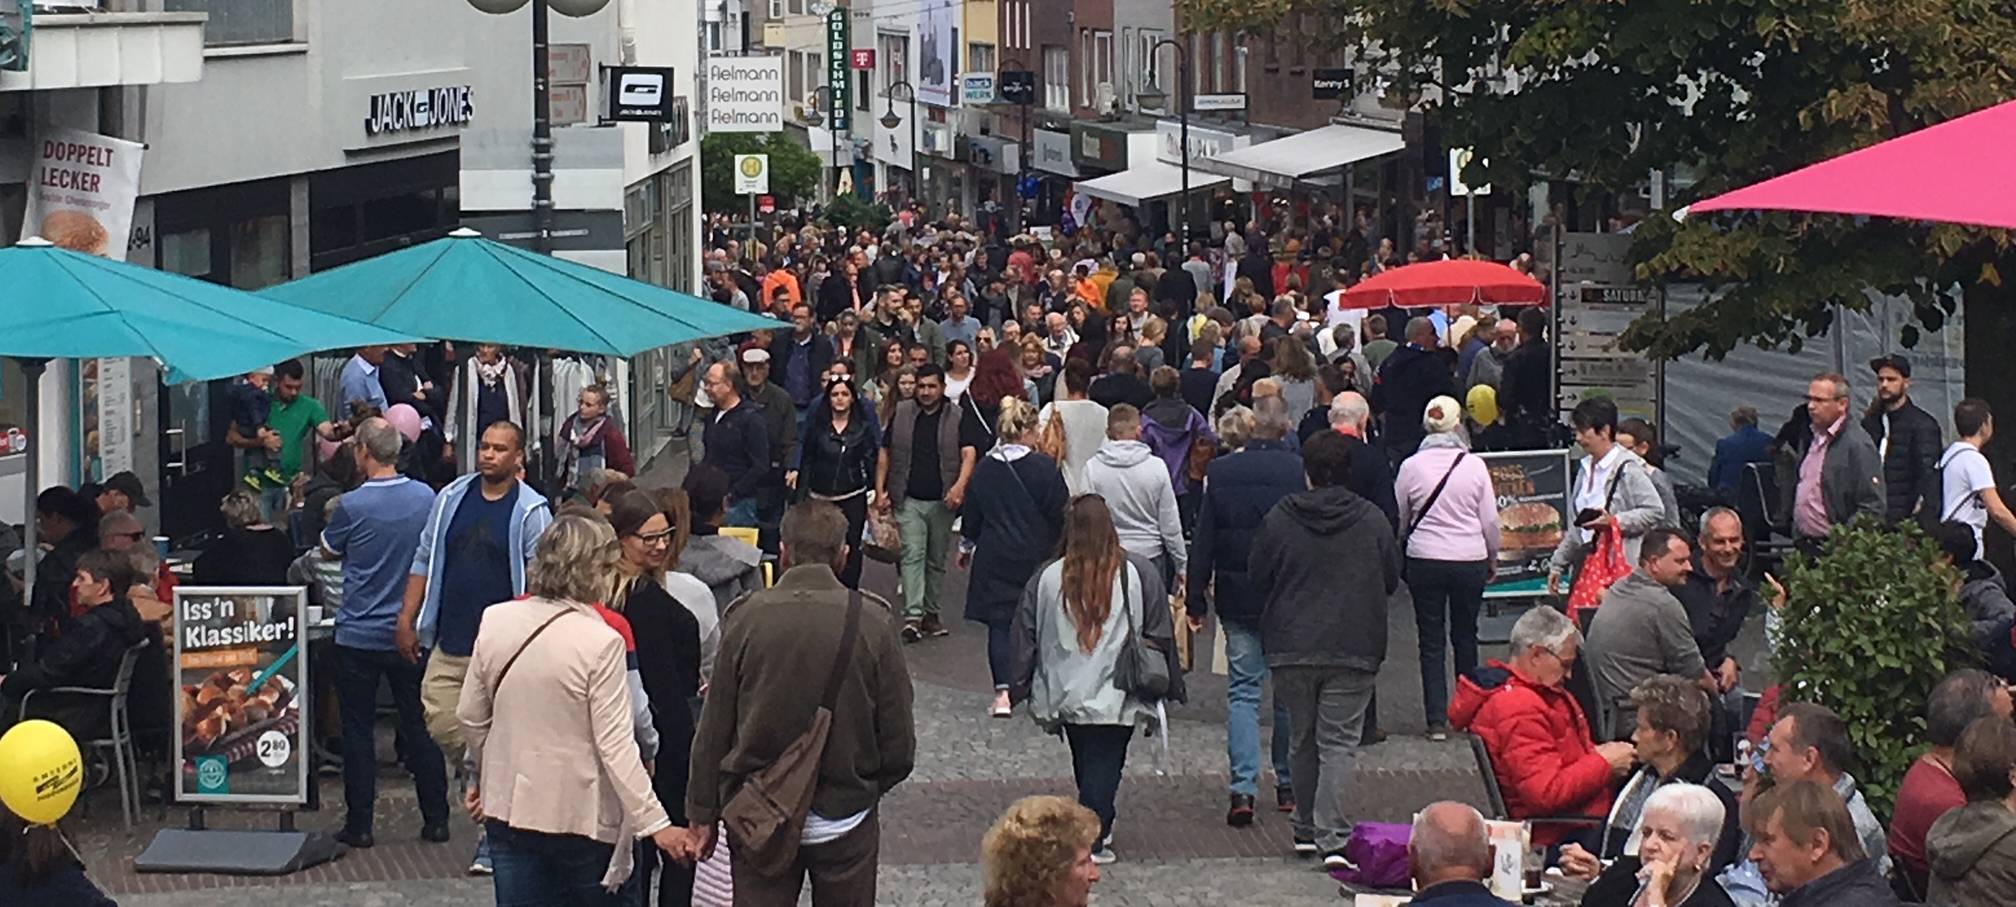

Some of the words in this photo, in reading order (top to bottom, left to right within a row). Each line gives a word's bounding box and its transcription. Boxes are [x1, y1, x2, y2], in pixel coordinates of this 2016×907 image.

[831, 12, 845, 128] GOLDSCHMIEDE
[367, 91, 414, 134] JACK
[428, 86, 475, 126] JONES
[42, 140, 113, 168] DOPPELT
[40, 165, 101, 193] LECKER
[186, 616, 294, 648] Klassiker!
